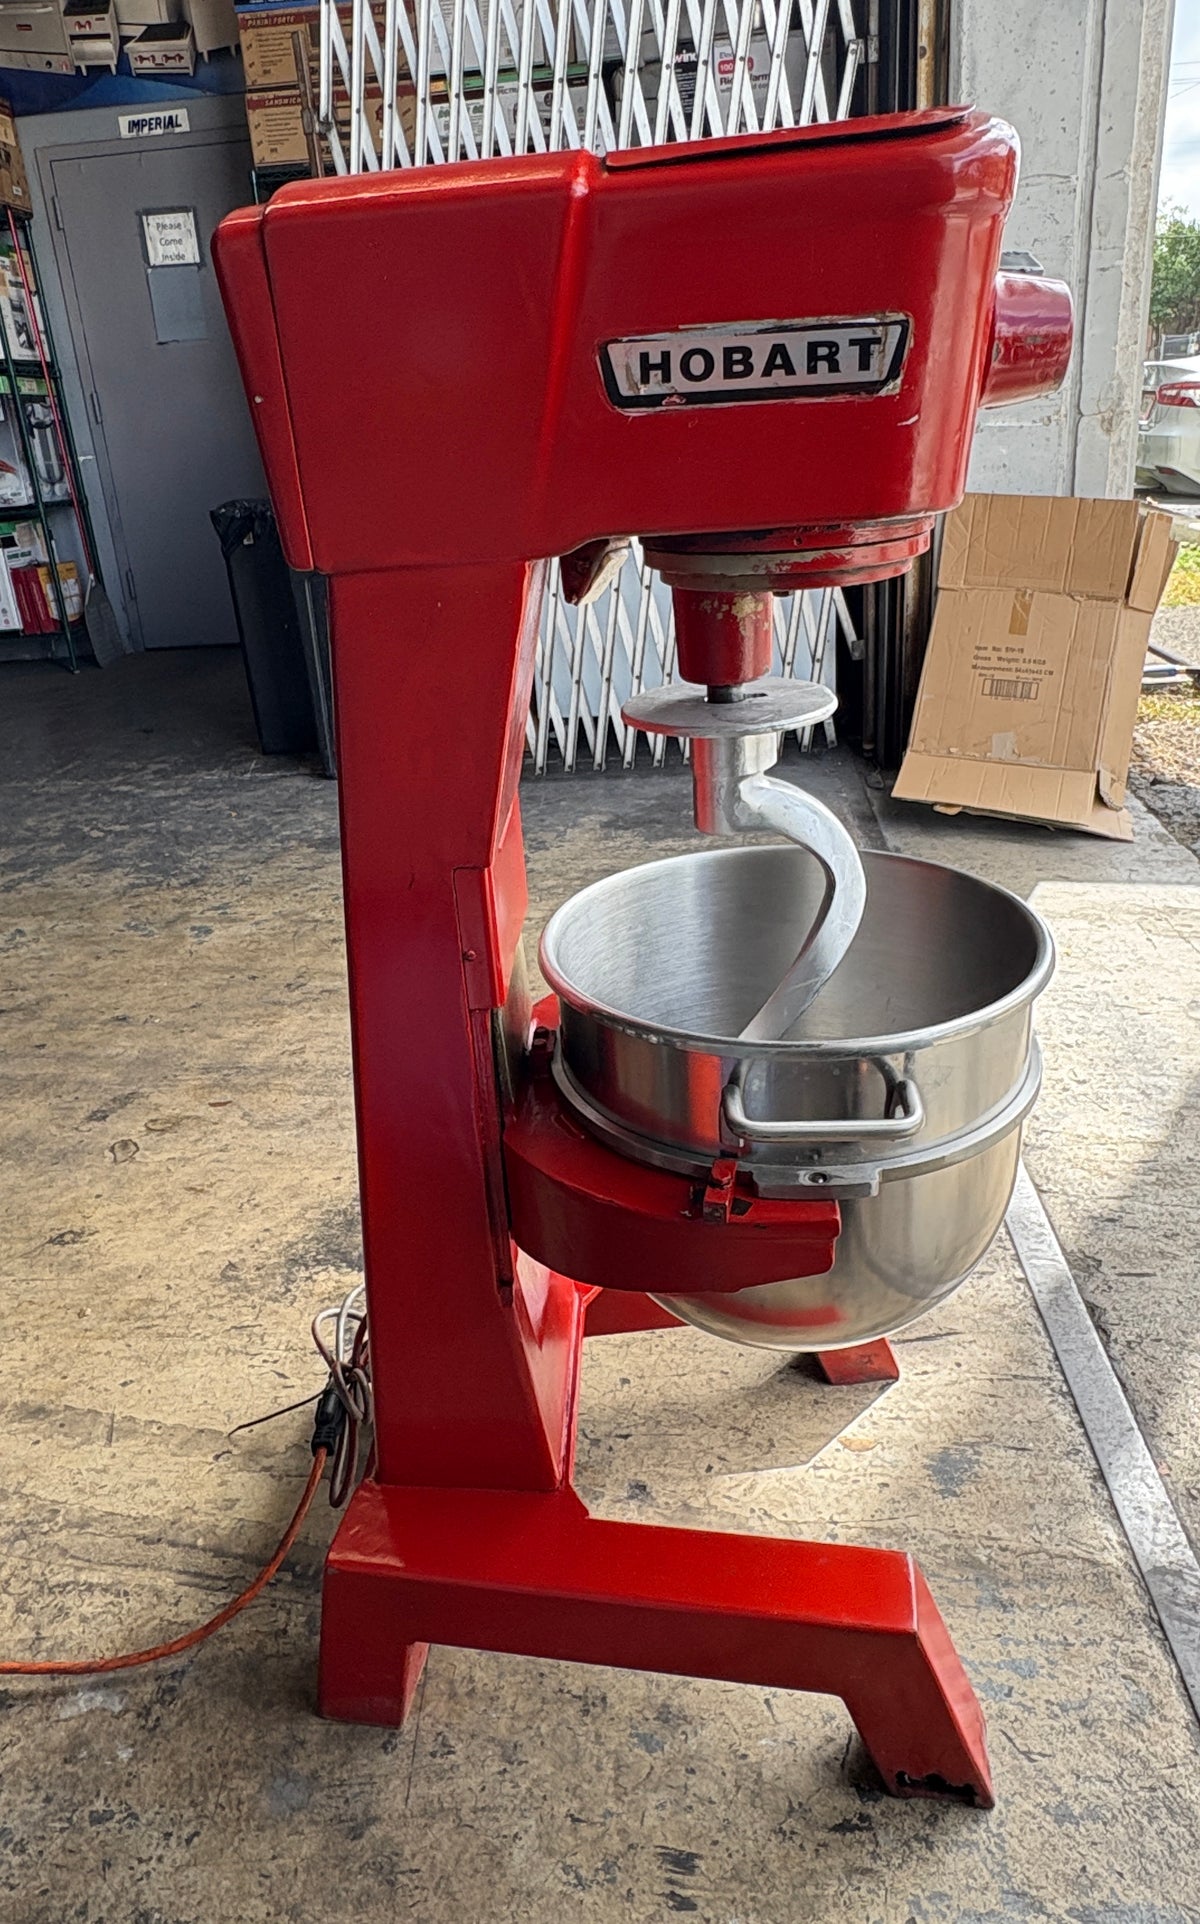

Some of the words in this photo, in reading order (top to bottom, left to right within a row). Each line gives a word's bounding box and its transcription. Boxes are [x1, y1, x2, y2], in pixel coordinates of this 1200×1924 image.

[128, 114, 182, 134] IMPERIAL
[156, 222, 182, 234] Please
[159, 237, 183, 247] Come
[639, 337, 882, 386] HOBART
